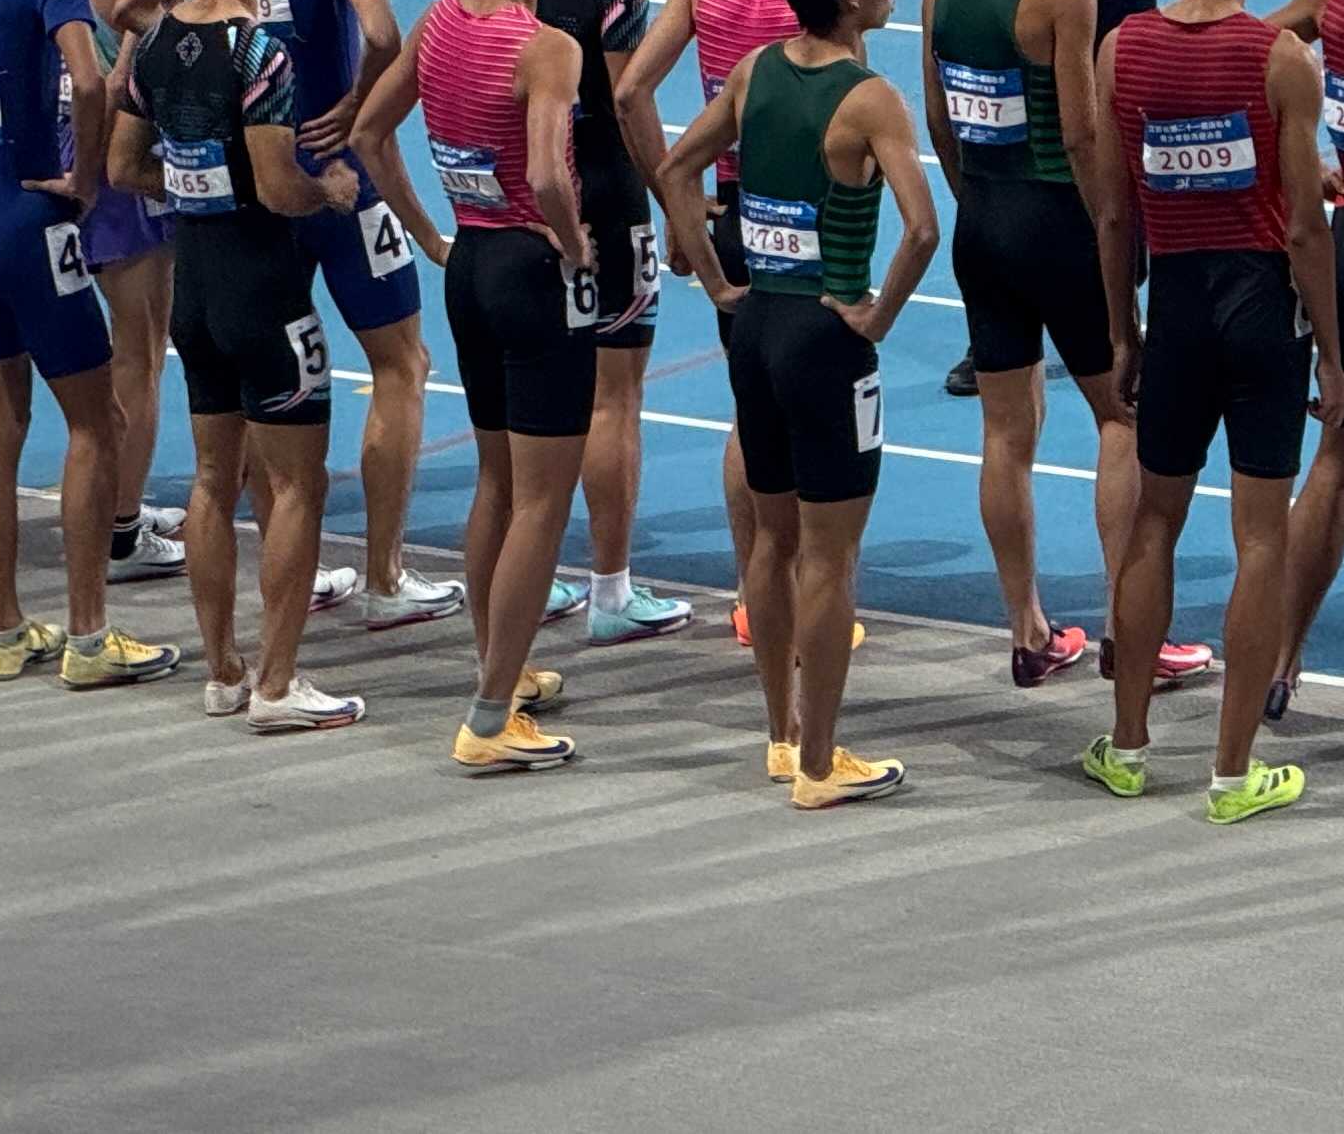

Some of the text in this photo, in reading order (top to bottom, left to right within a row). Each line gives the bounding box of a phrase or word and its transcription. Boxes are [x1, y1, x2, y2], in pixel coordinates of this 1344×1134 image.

[950, 95, 1003, 123] 1797
[1158, 147, 1231, 170] 2009
[58, 232, 85, 278] 4
[374, 212, 403, 259] 4
[640, 235, 657, 283] 5
[747, 225, 800, 253] 1798
[573, 267, 596, 315] 6
[299, 326, 327, 375] 5
[863, 385, 881, 437] 7
